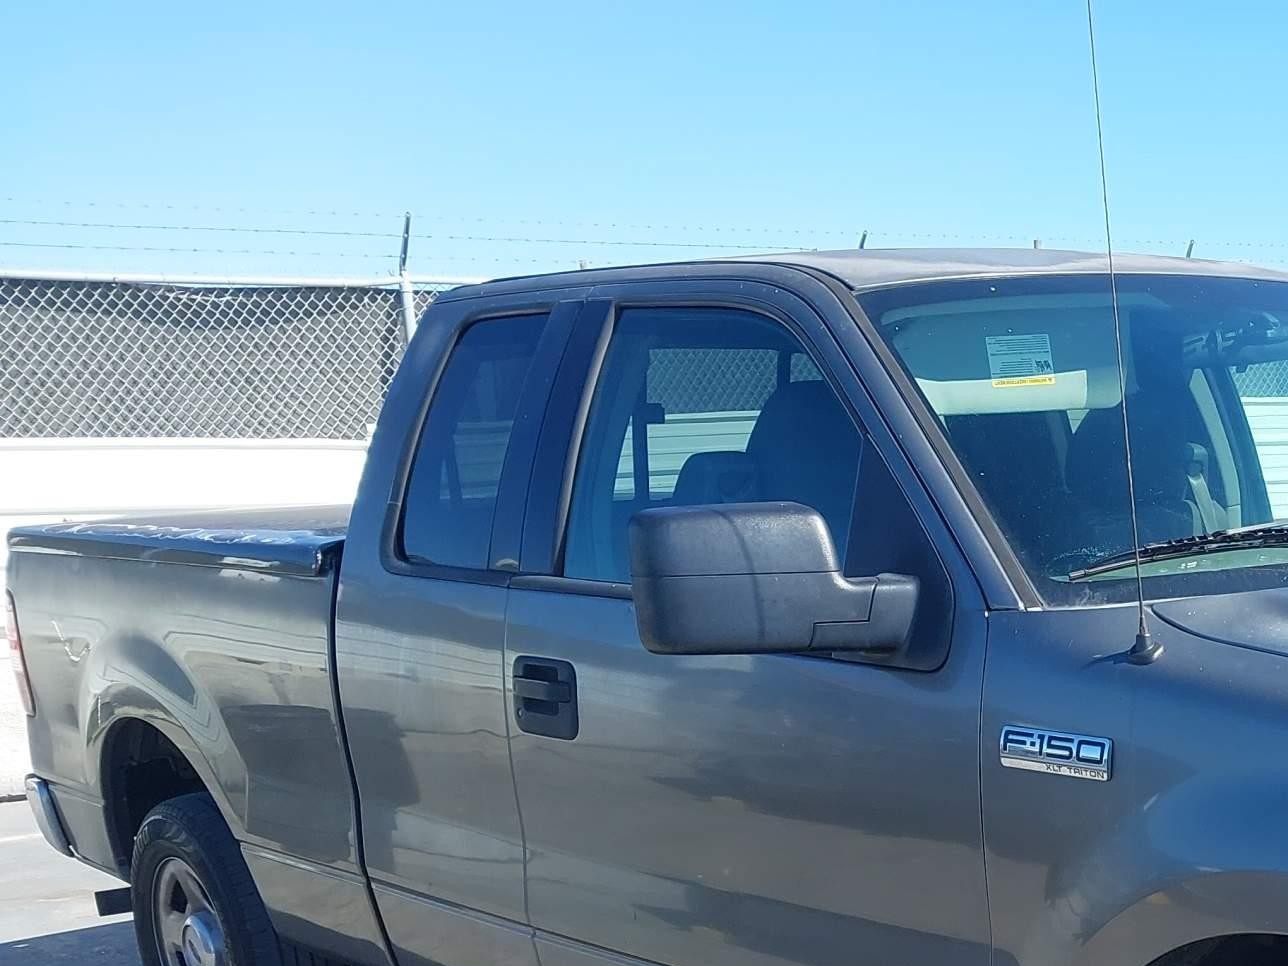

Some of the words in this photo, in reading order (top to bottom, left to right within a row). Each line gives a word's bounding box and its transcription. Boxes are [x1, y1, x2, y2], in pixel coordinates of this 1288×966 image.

[1002, 728, 1106, 765] F-150
[1045, 762, 1063, 774] XLT
[1068, 766, 1105, 780] TRITON
